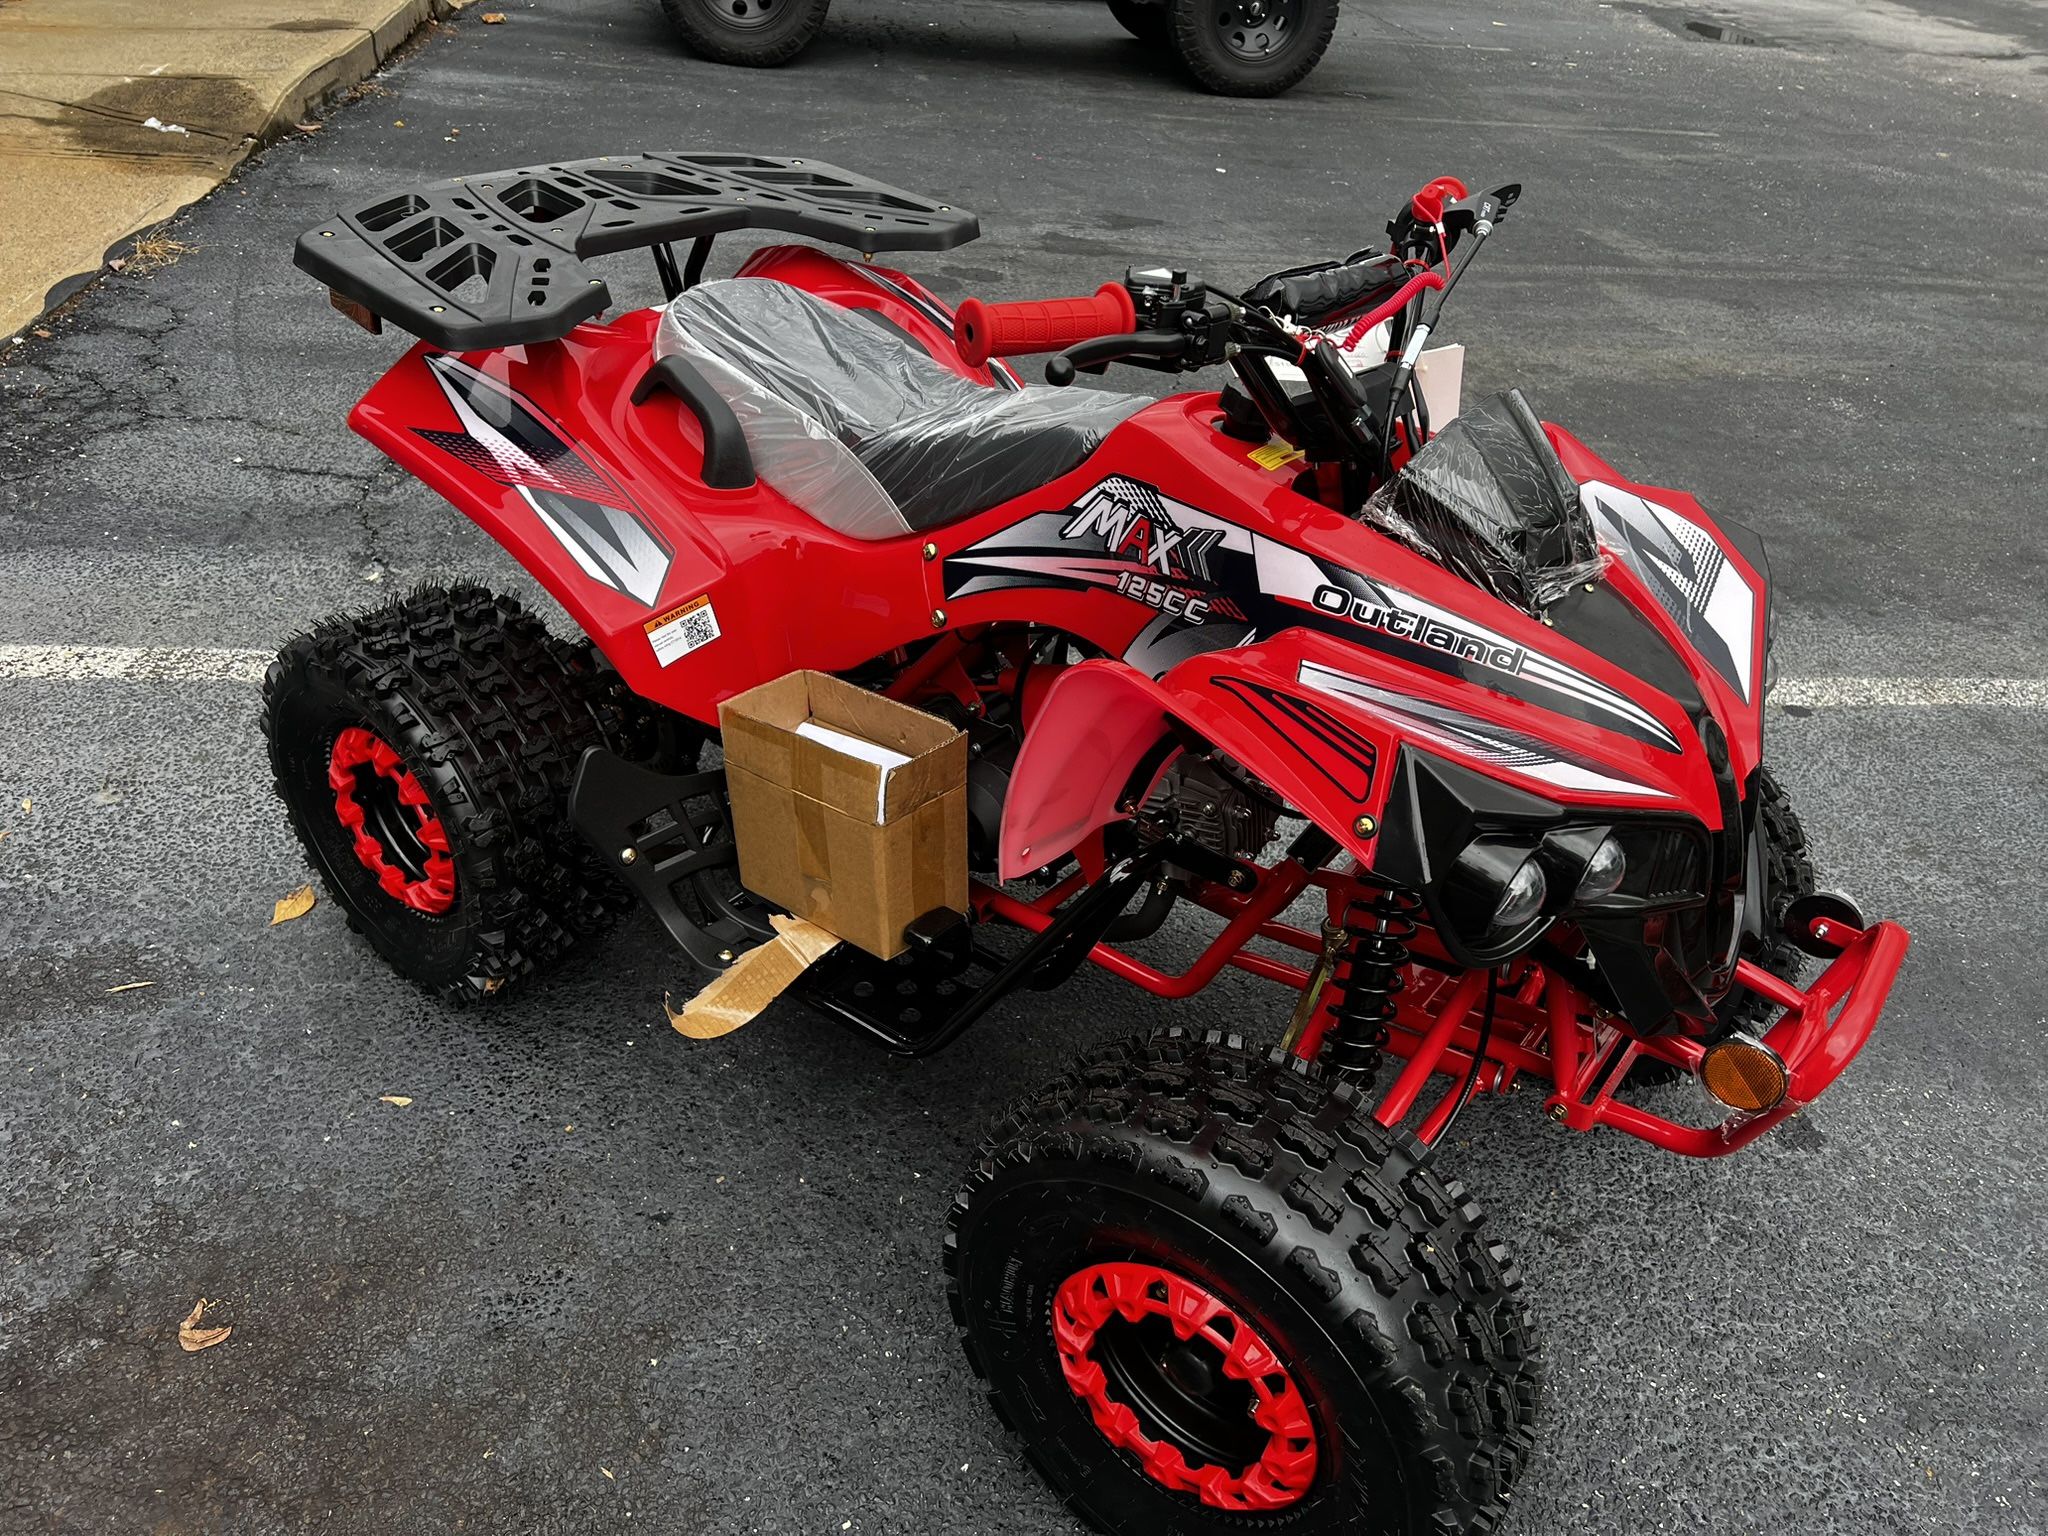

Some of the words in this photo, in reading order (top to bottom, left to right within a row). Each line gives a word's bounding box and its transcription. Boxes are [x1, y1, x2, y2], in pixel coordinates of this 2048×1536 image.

[1063, 493, 1184, 577] MAX
[663, 601, 700, 622] WARNING
[1117, 571, 1210, 625] 125CC
[1312, 583, 1527, 676] Outland
